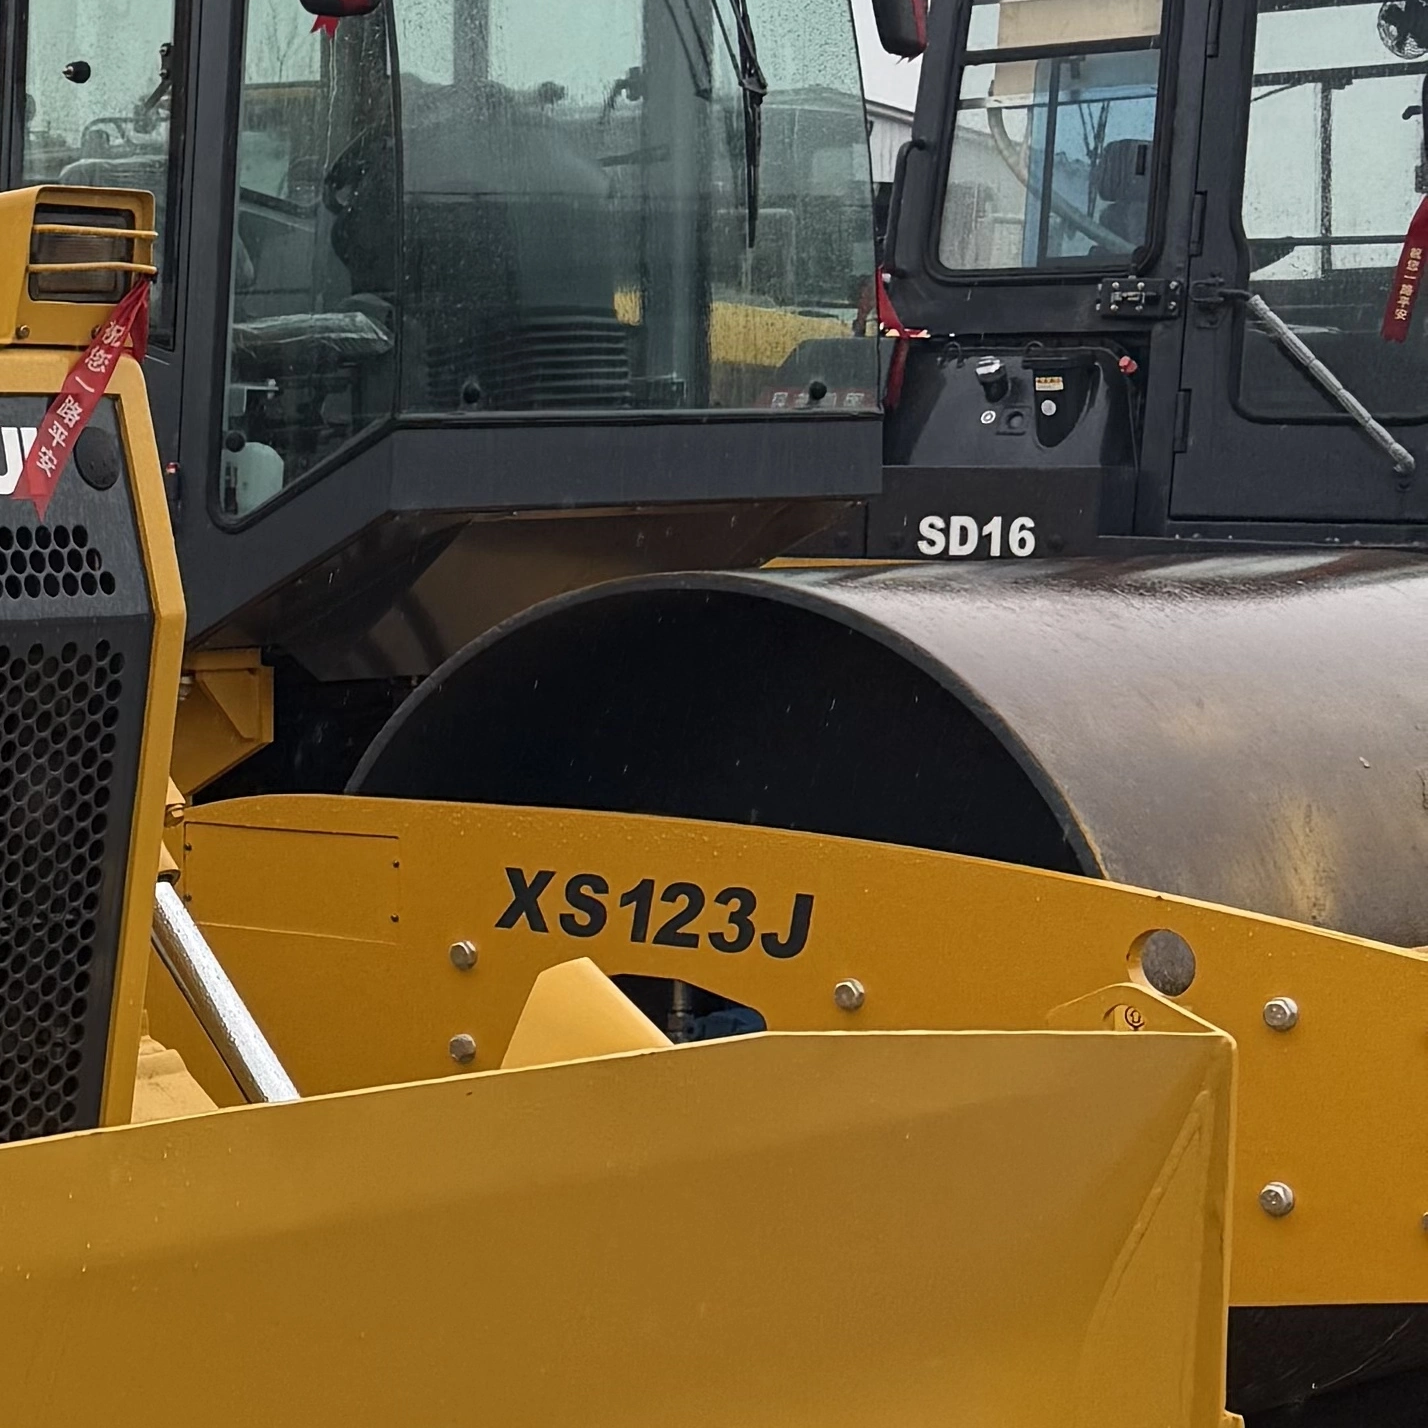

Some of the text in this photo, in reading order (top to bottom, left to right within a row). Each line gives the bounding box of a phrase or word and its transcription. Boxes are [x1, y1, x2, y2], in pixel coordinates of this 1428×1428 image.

[35, 320, 126, 479] 祝您一路平安
[917, 515, 1036, 557] SD16
[494, 867, 815, 959] XS123J
